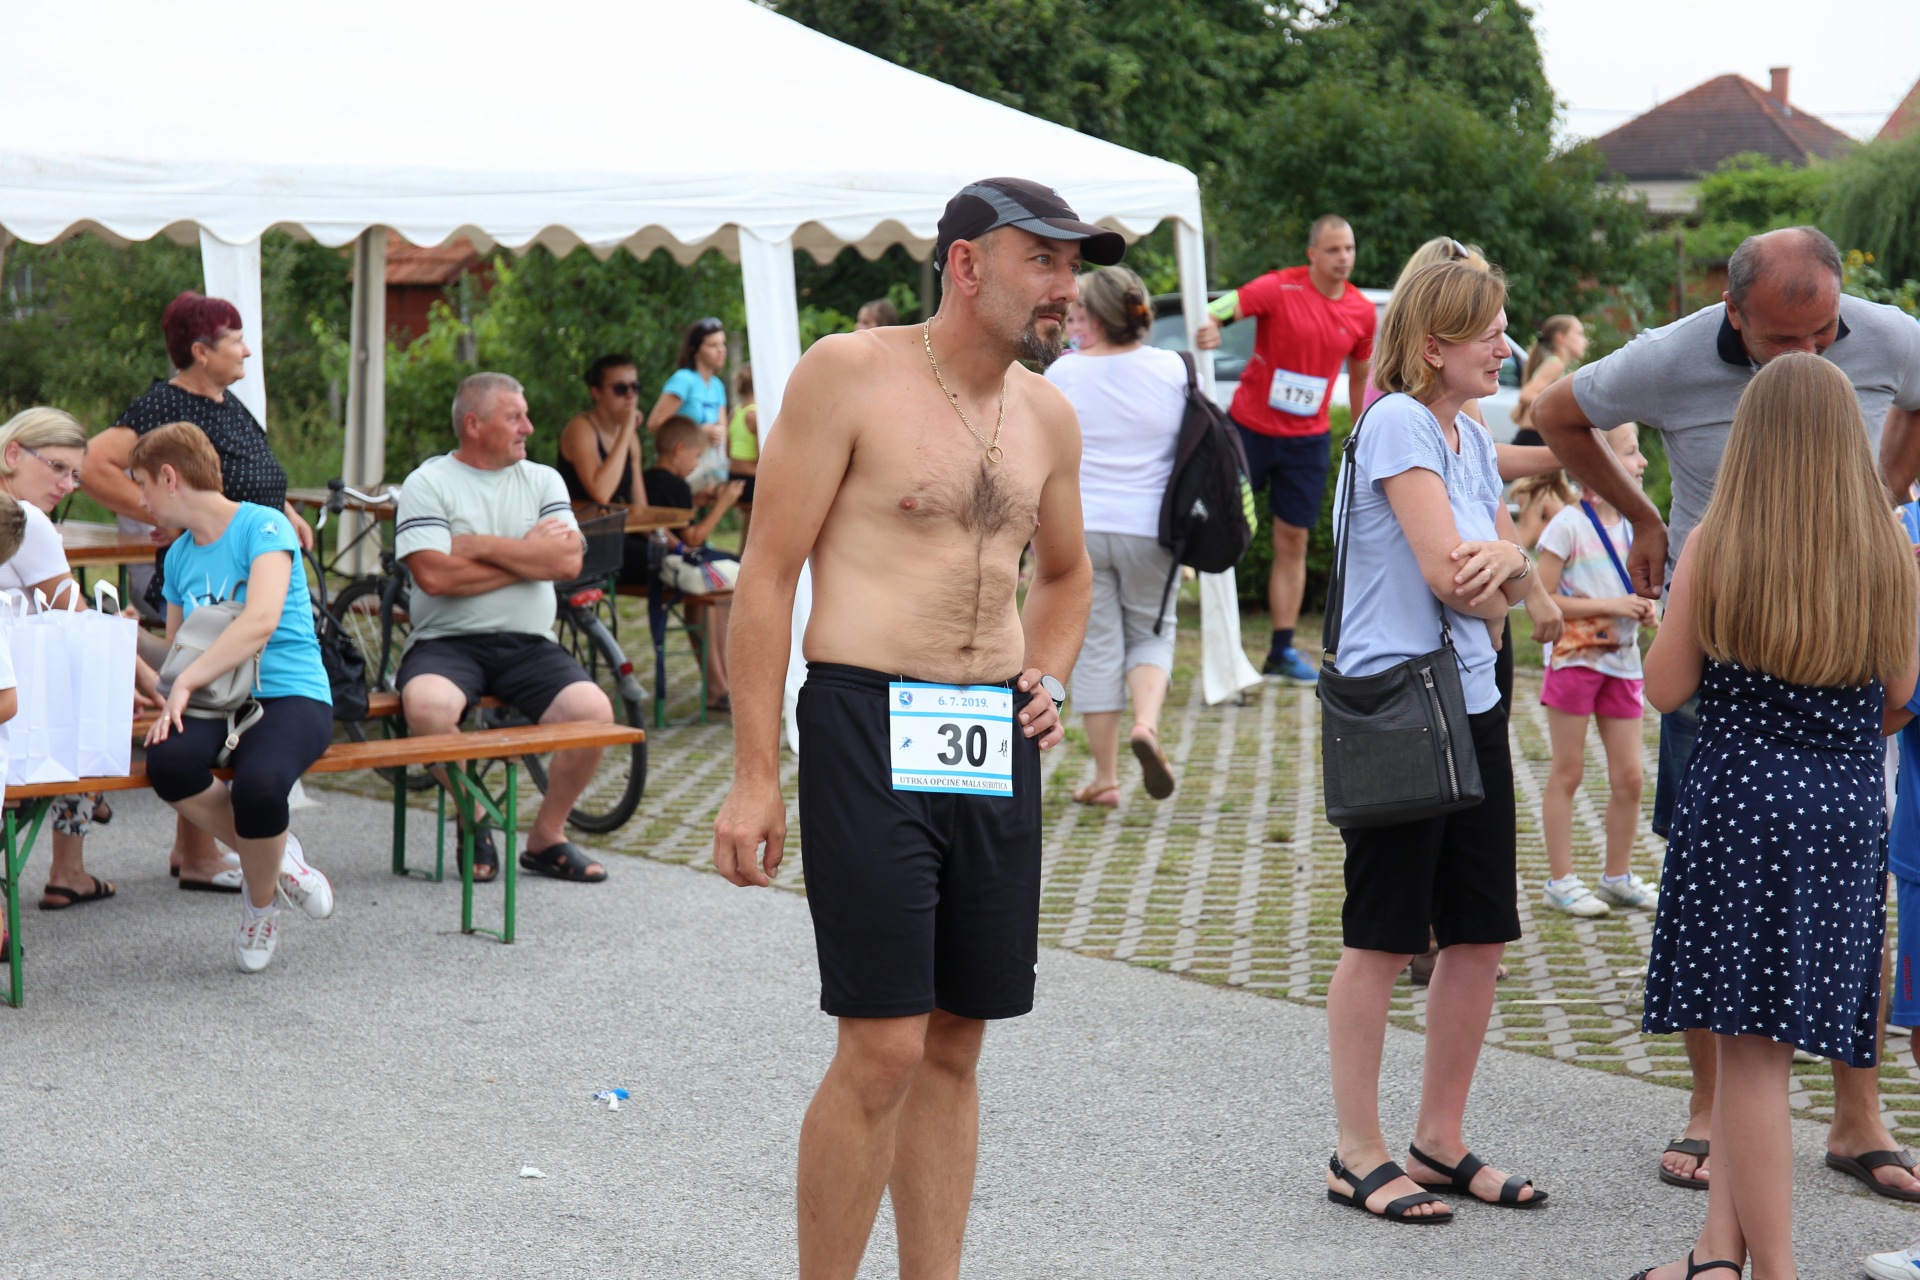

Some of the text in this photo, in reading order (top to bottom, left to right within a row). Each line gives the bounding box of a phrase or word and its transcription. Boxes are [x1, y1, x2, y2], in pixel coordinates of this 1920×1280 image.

[1285, 386, 1314, 404] 179
[961, 697, 989, 708] 2019.
[937, 723, 988, 767] 30
[900, 776, 1008, 790] UTRKA OPĆINE MALA SUBOTICA
